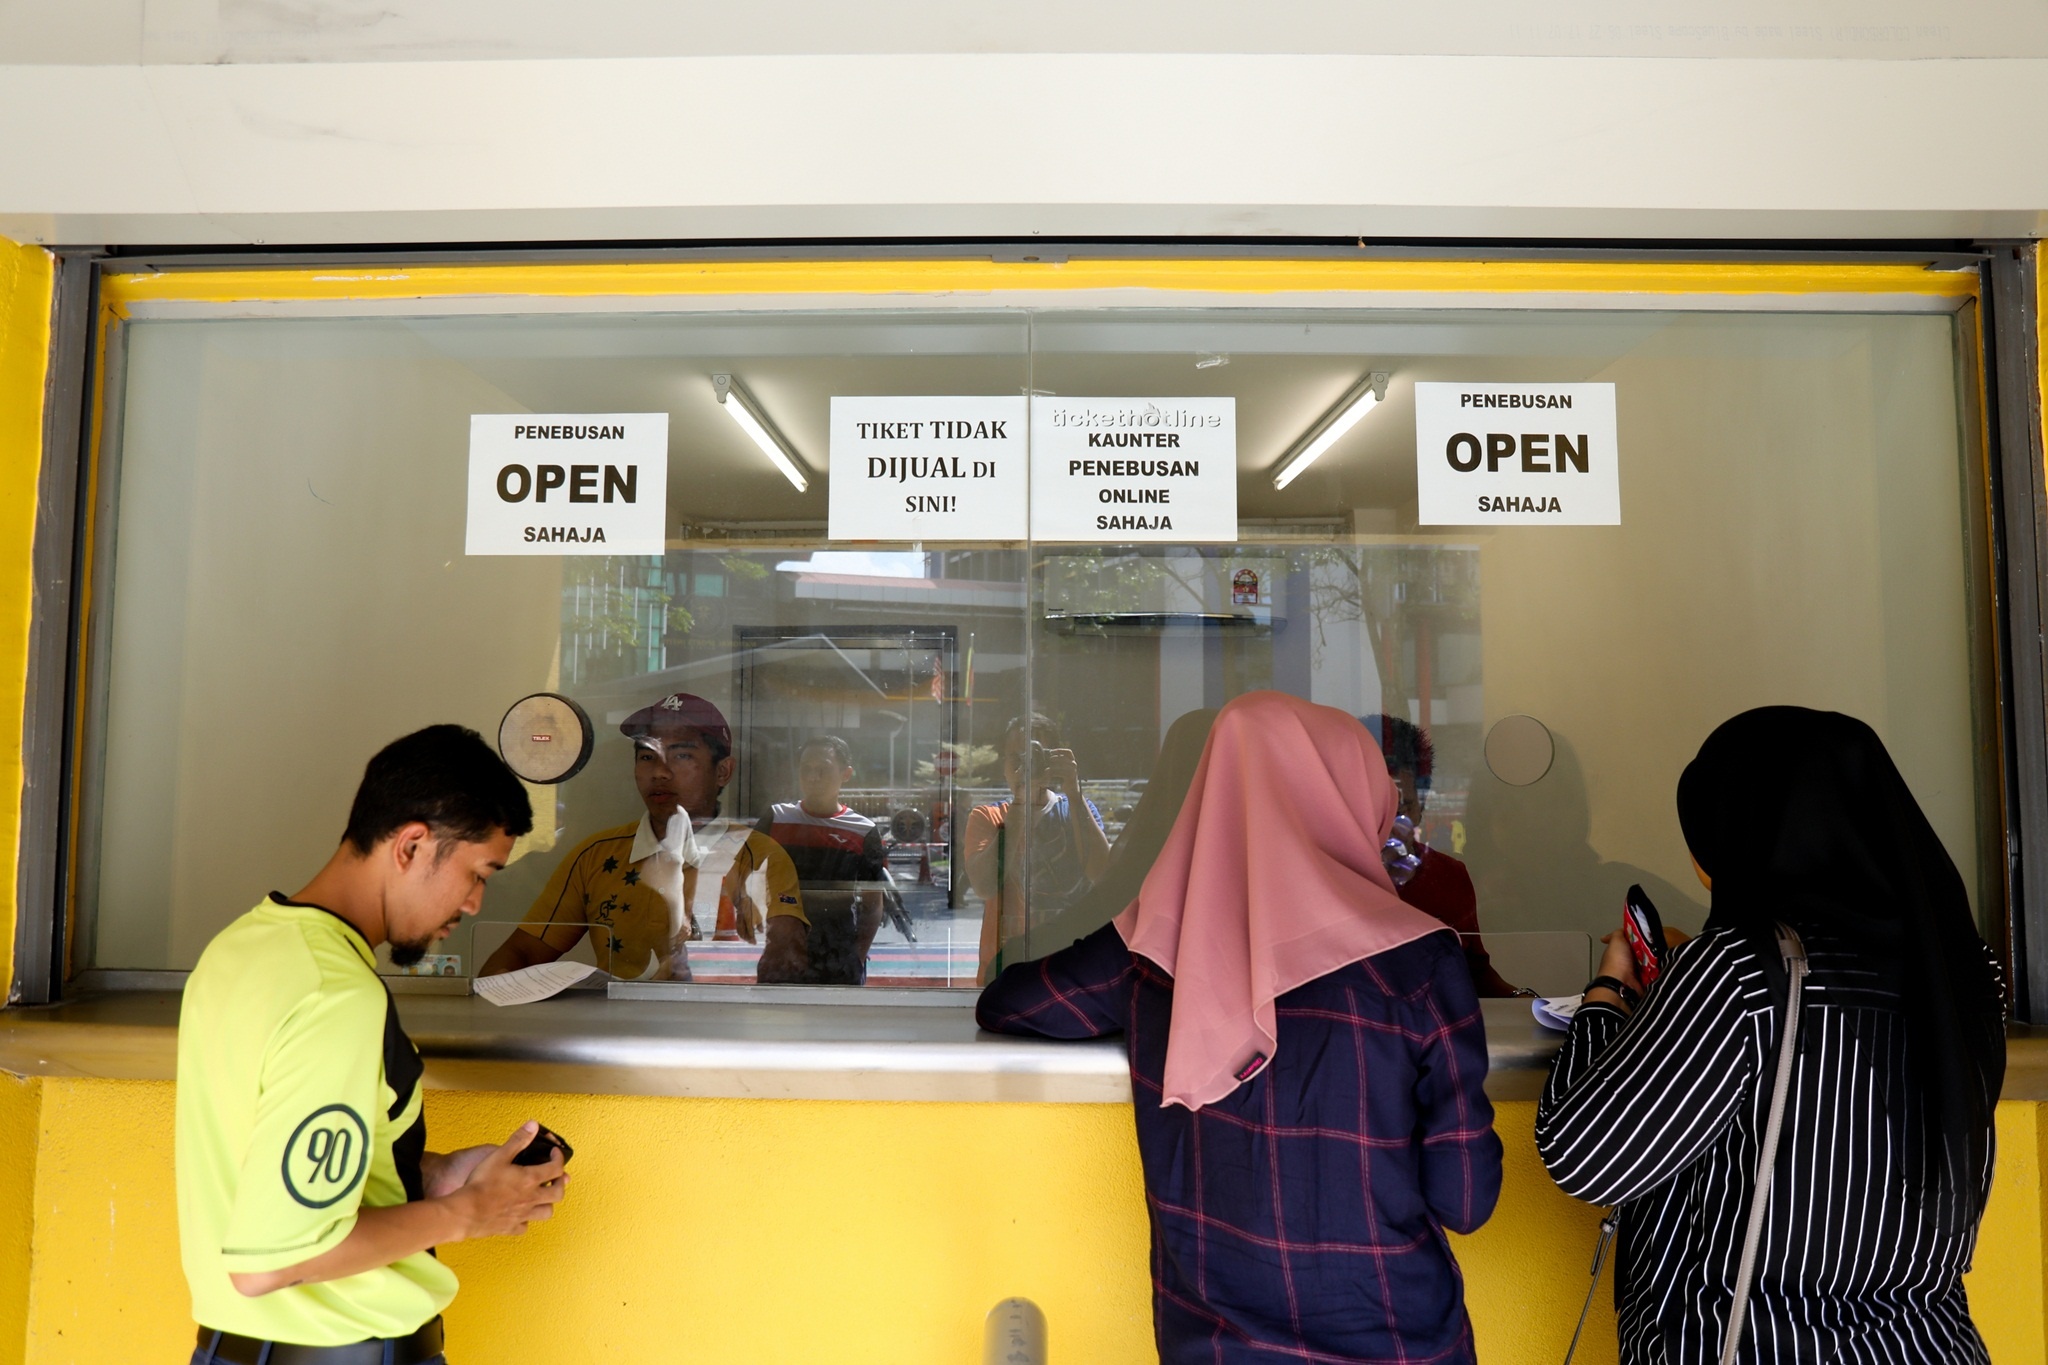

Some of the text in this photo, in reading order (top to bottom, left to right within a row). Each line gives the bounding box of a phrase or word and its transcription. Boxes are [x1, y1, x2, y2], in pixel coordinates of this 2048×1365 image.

[1460, 393, 1572, 409] PENEBUSAN
[1052, 408, 1222, 428] tickethotline
[514, 425, 625, 440] PENEBUSAN
[856, 420, 1008, 439] TIKET TIDAK
[1088, 433, 1180, 448] KAUNTER
[1446, 432, 1590, 474] OPEN
[867, 456, 996, 484] DIJUAL DI
[1069, 460, 1199, 477] PENEBUSAN
[496, 463, 638, 504] OPEN
[905, 495, 957, 513] SINI!
[1098, 488, 1170, 504] ONLINE
[1478, 495, 1562, 513] SAHAJA
[1096, 515, 1173, 530] SAHAJA
[523, 526, 606, 543] SAHAJA
[660, 694, 684, 712] LA
[307, 1127, 353, 1184] 90
